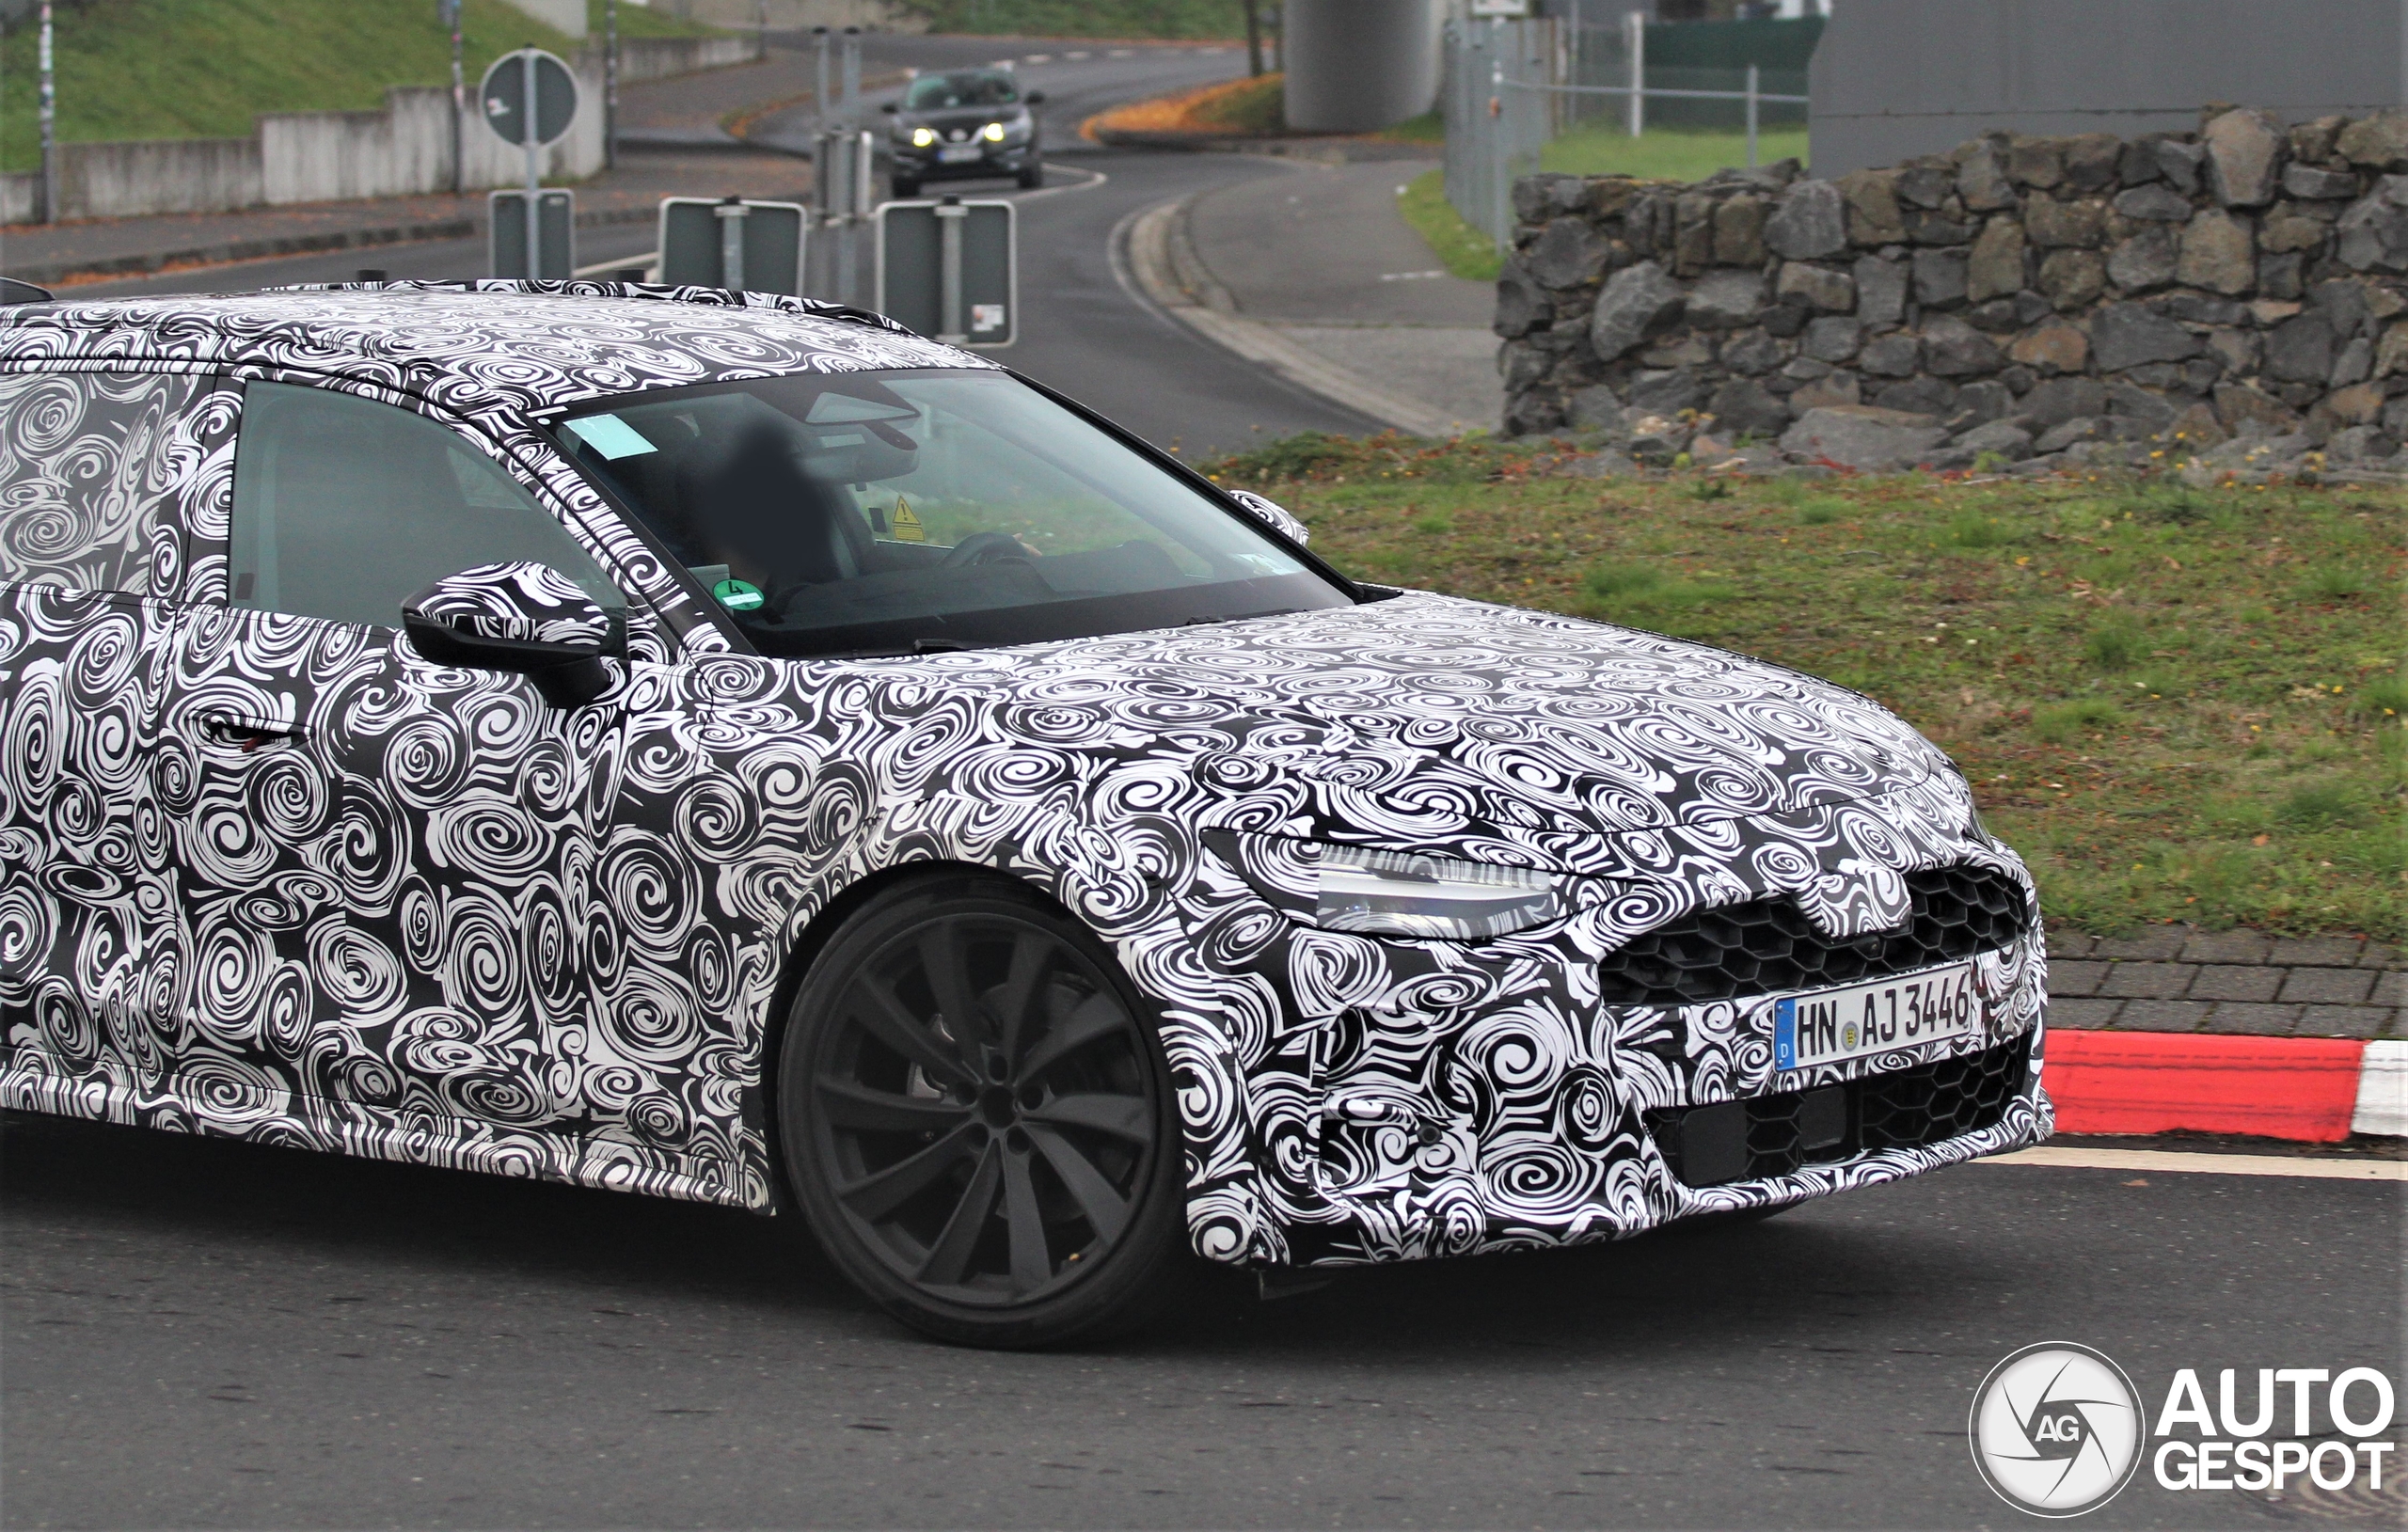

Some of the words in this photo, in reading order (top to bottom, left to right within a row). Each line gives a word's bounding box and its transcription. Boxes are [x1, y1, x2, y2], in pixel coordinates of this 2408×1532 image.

[728, 580, 743, 594] 4
[1798, 1000, 1837, 1058] HN
[1861, 988, 1896, 1047] AJ
[1905, 972, 1969, 1037] 3446
[1781, 1043, 1789, 1058] D
